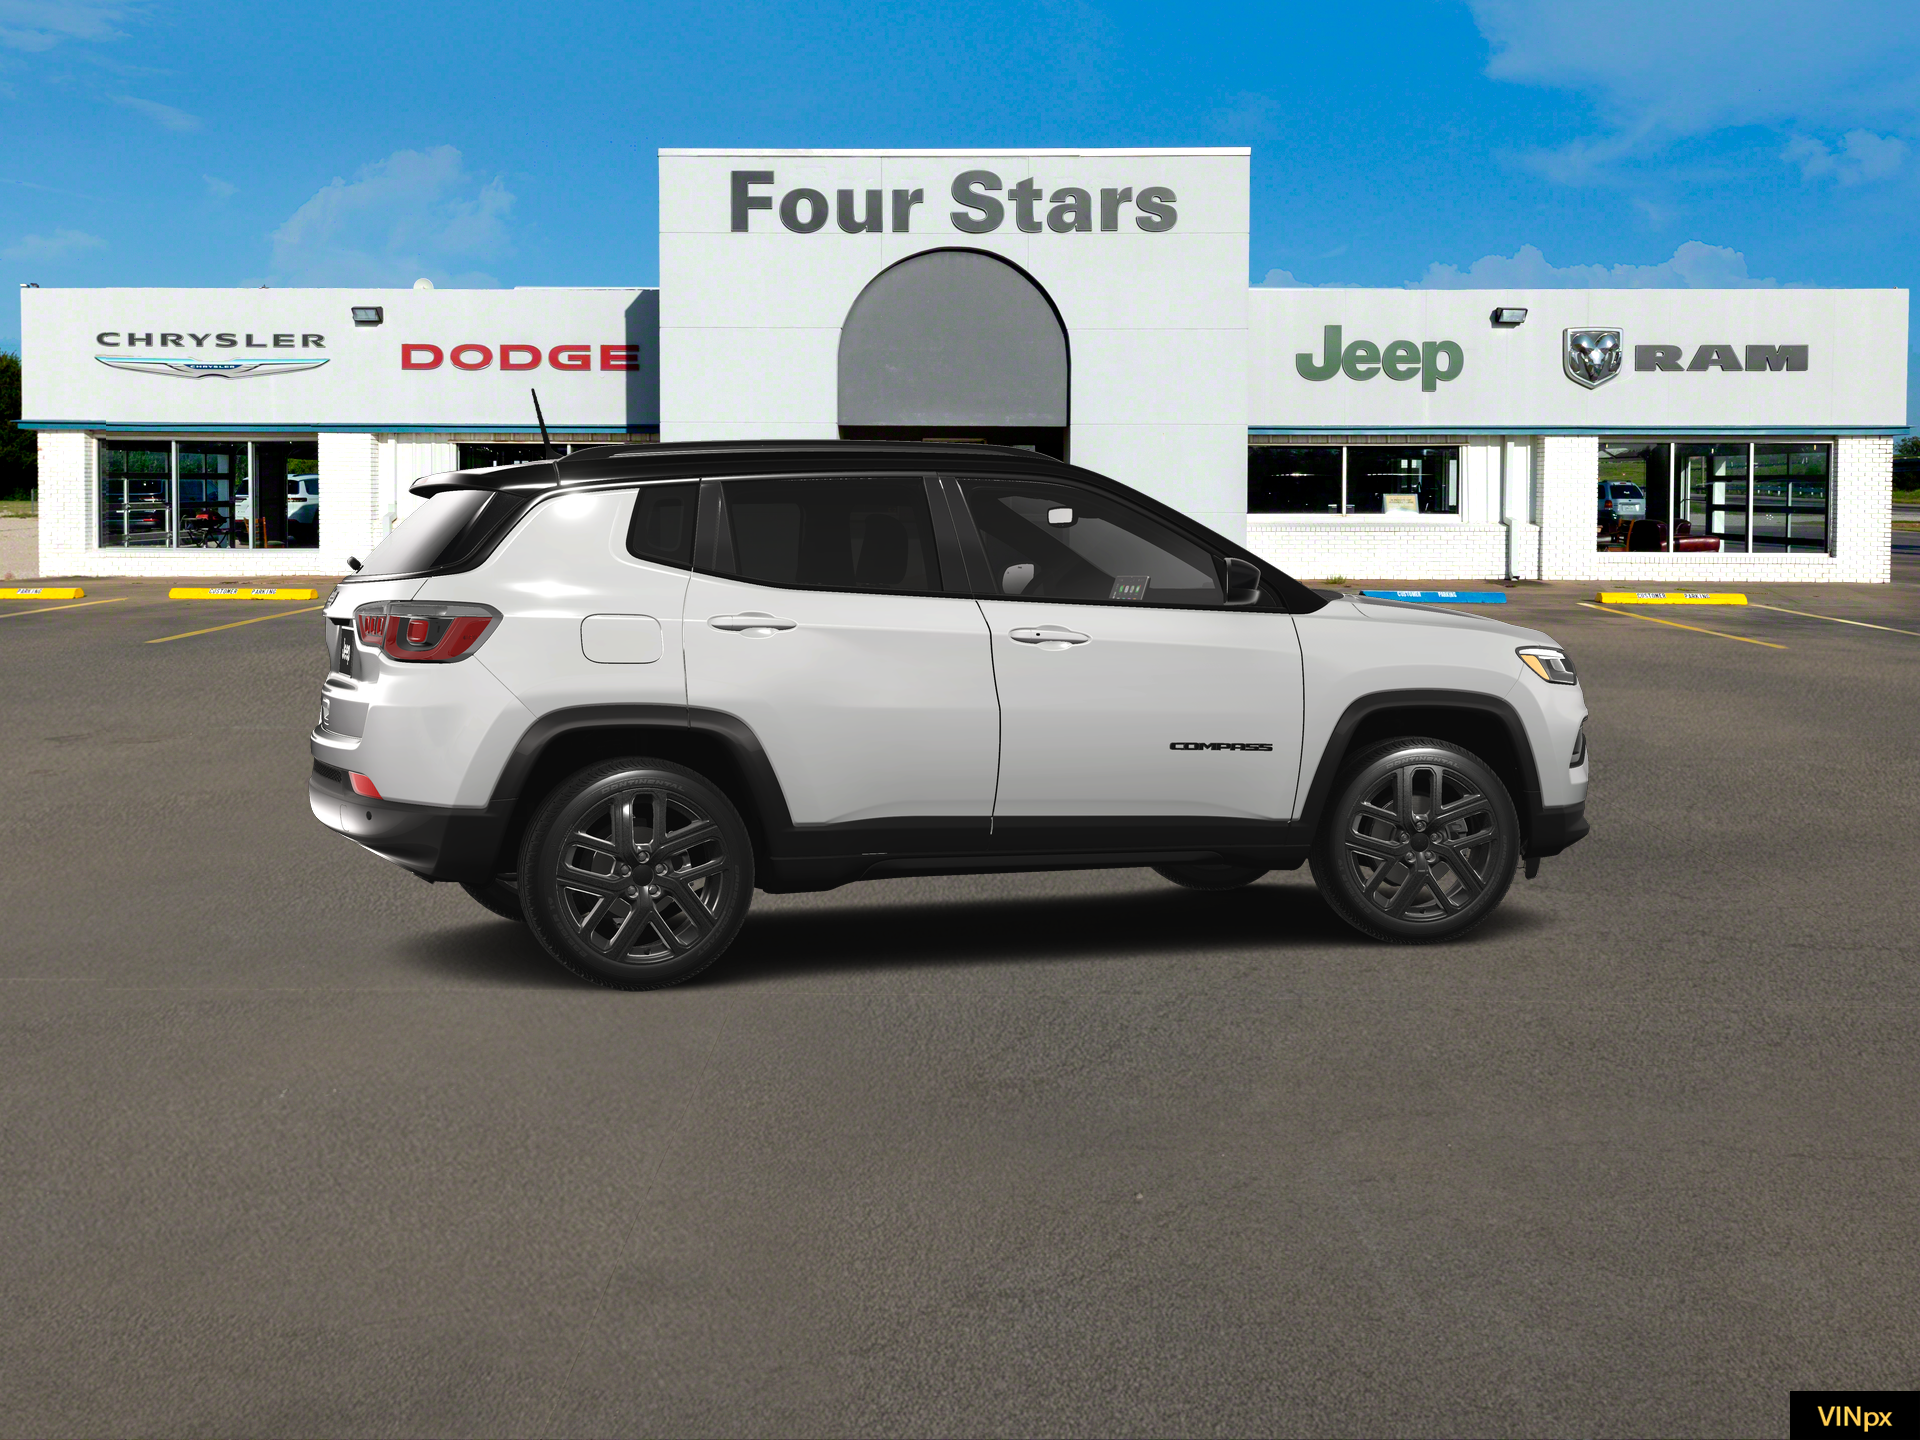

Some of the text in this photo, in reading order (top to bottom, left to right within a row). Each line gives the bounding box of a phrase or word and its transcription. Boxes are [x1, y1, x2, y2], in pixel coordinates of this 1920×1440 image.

[730, 170, 1178, 234] Four Stars
[96, 332, 326, 348] CHRYSLER
[401, 343, 640, 371] DODGE
[1296, 325, 1464, 392] Jeep
[1635, 344, 1809, 372] RAM
[1169, 742, 1273, 751] COMPASS
[601, 778, 685, 794] CONTINENTAL
